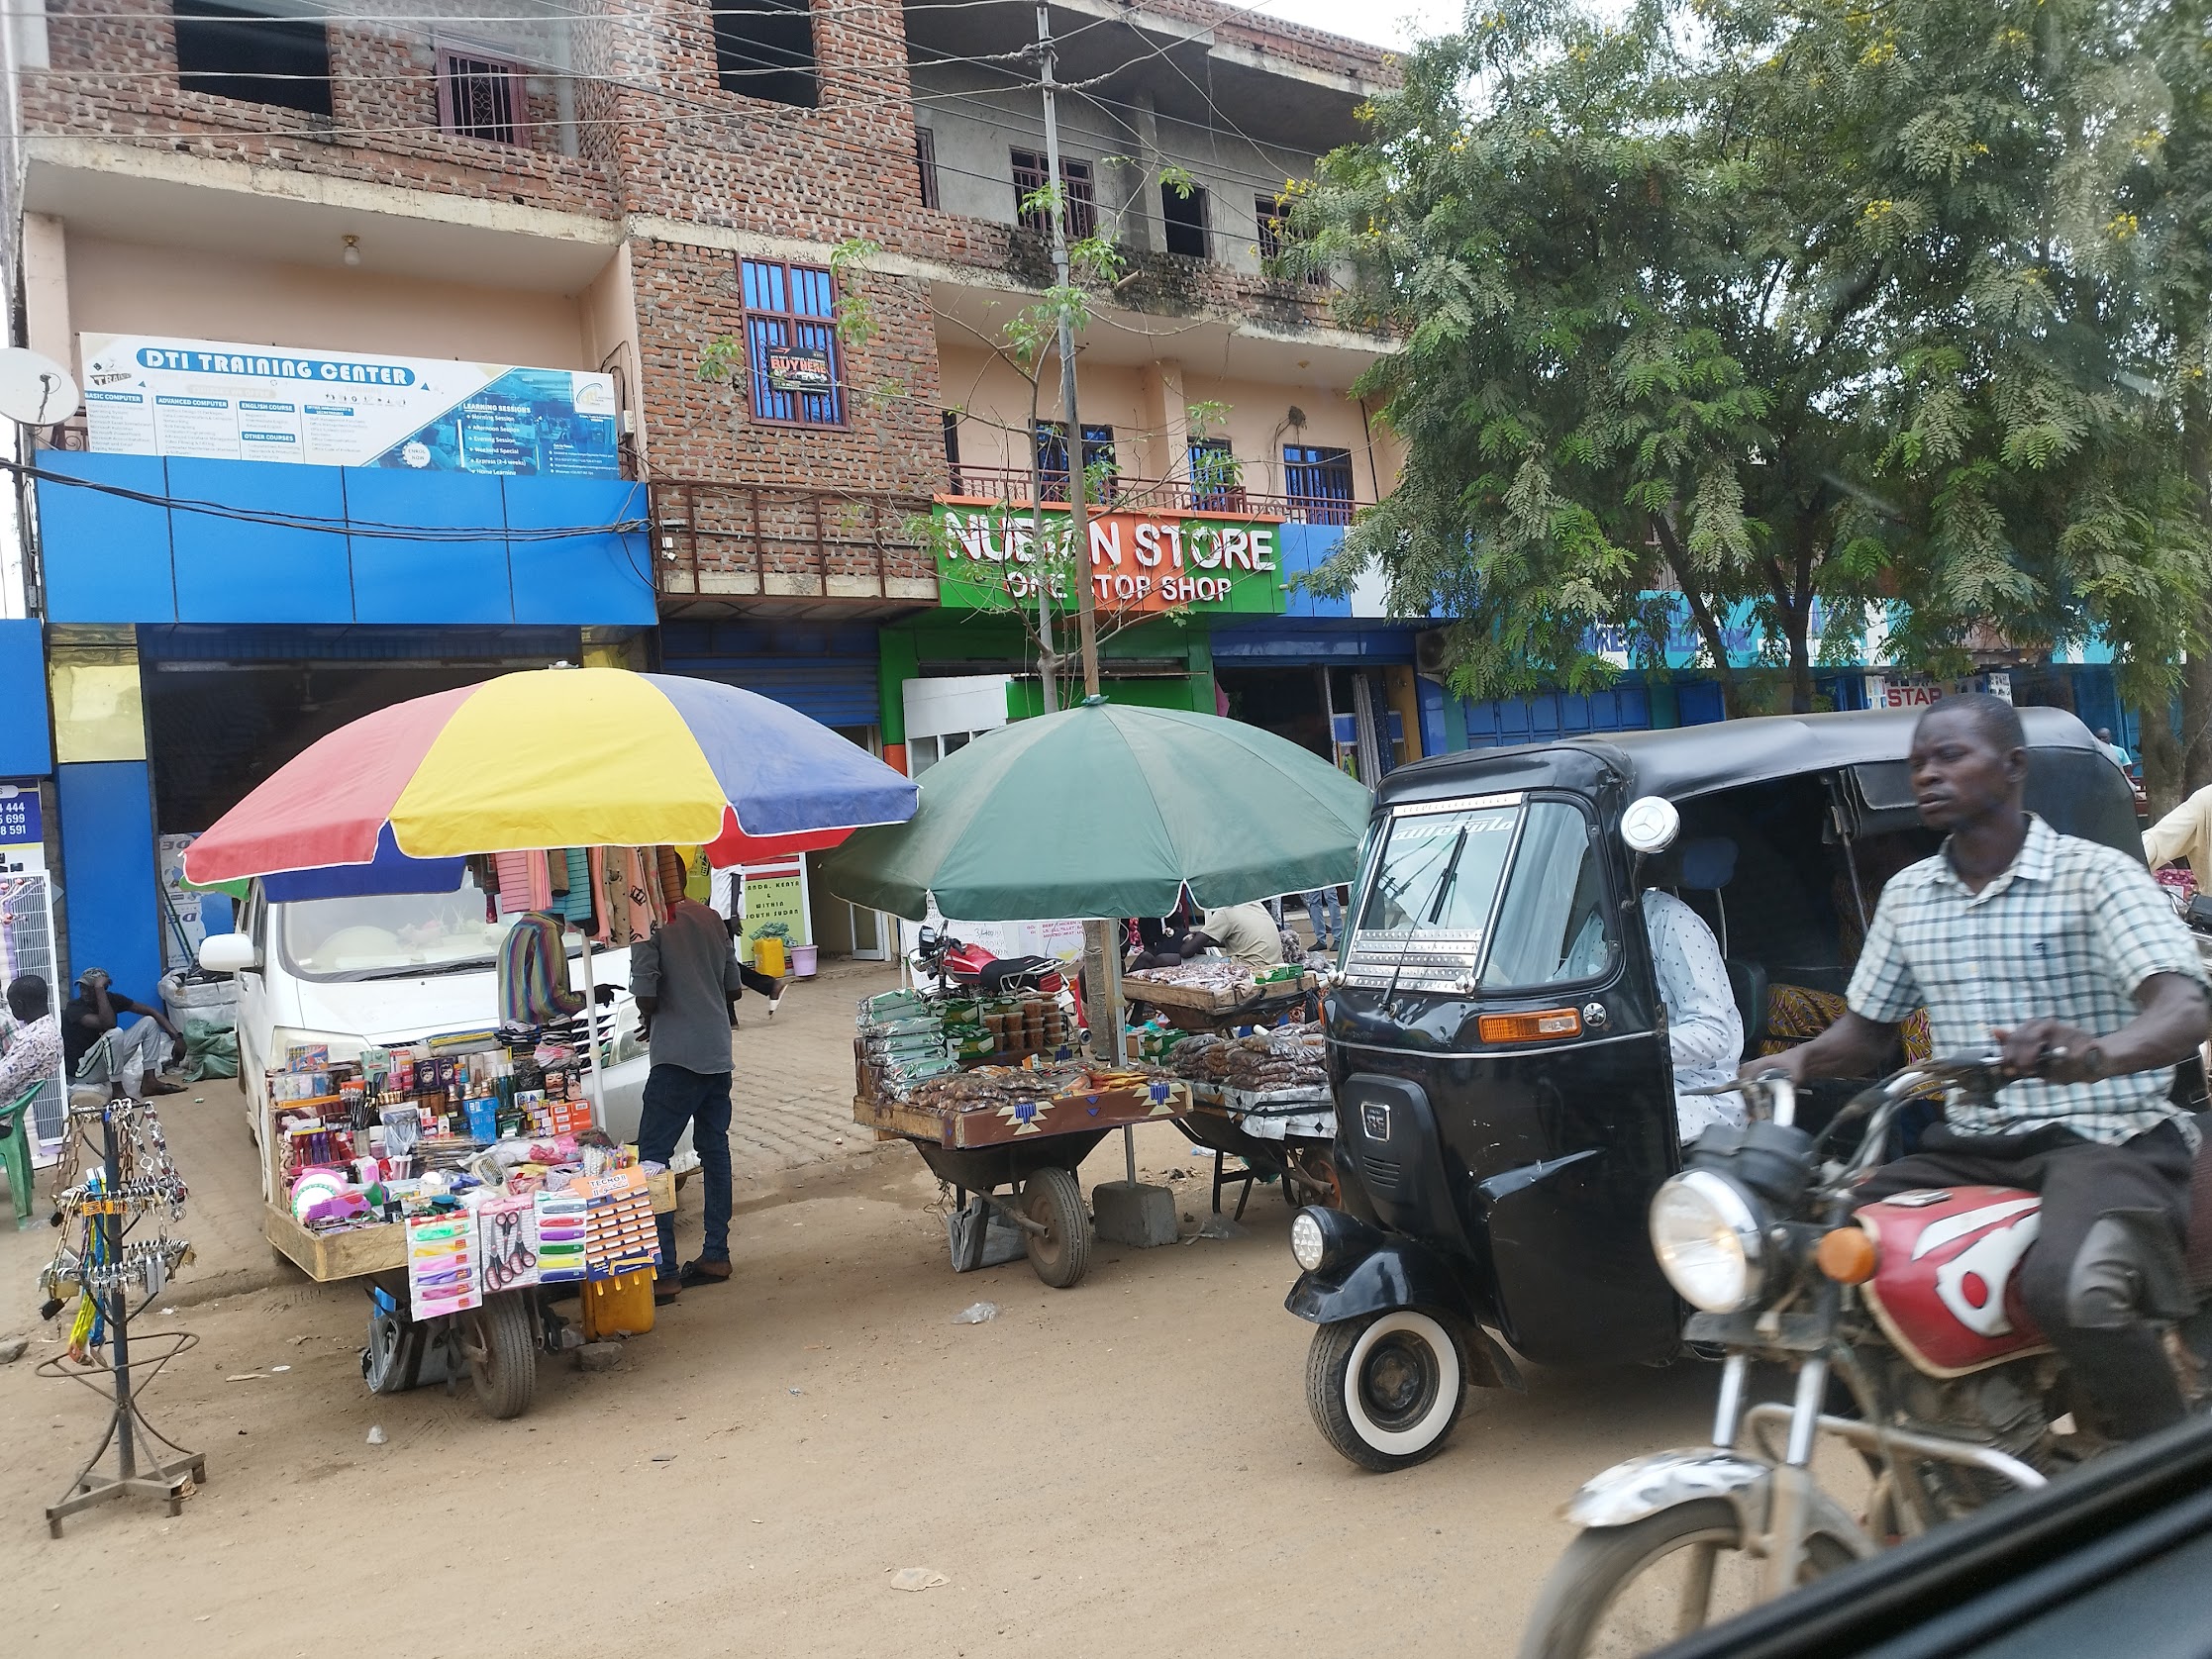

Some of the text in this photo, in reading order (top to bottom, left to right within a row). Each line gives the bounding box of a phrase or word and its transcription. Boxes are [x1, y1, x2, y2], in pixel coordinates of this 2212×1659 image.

[146, 349, 189, 370] DTI
[199, 353, 313, 379] TRAINING
[320, 361, 409, 386] CENTER
[770, 358, 799, 371] BUY
[799, 359, 827, 374] HERE
[104, 394, 142, 403] COMPUTER
[192, 399, 227, 408] COMPUTER
[462, 403, 531, 414] LEARNING SESSIONS
[1135, 523, 1277, 572] STORE
[1089, 574, 1150, 601] TOP
[1161, 576, 1232, 603] SHOP
[6, 802, 26, 813] 444
[5, 813, 26, 825] 699
[9, 824, 27, 835] 591
